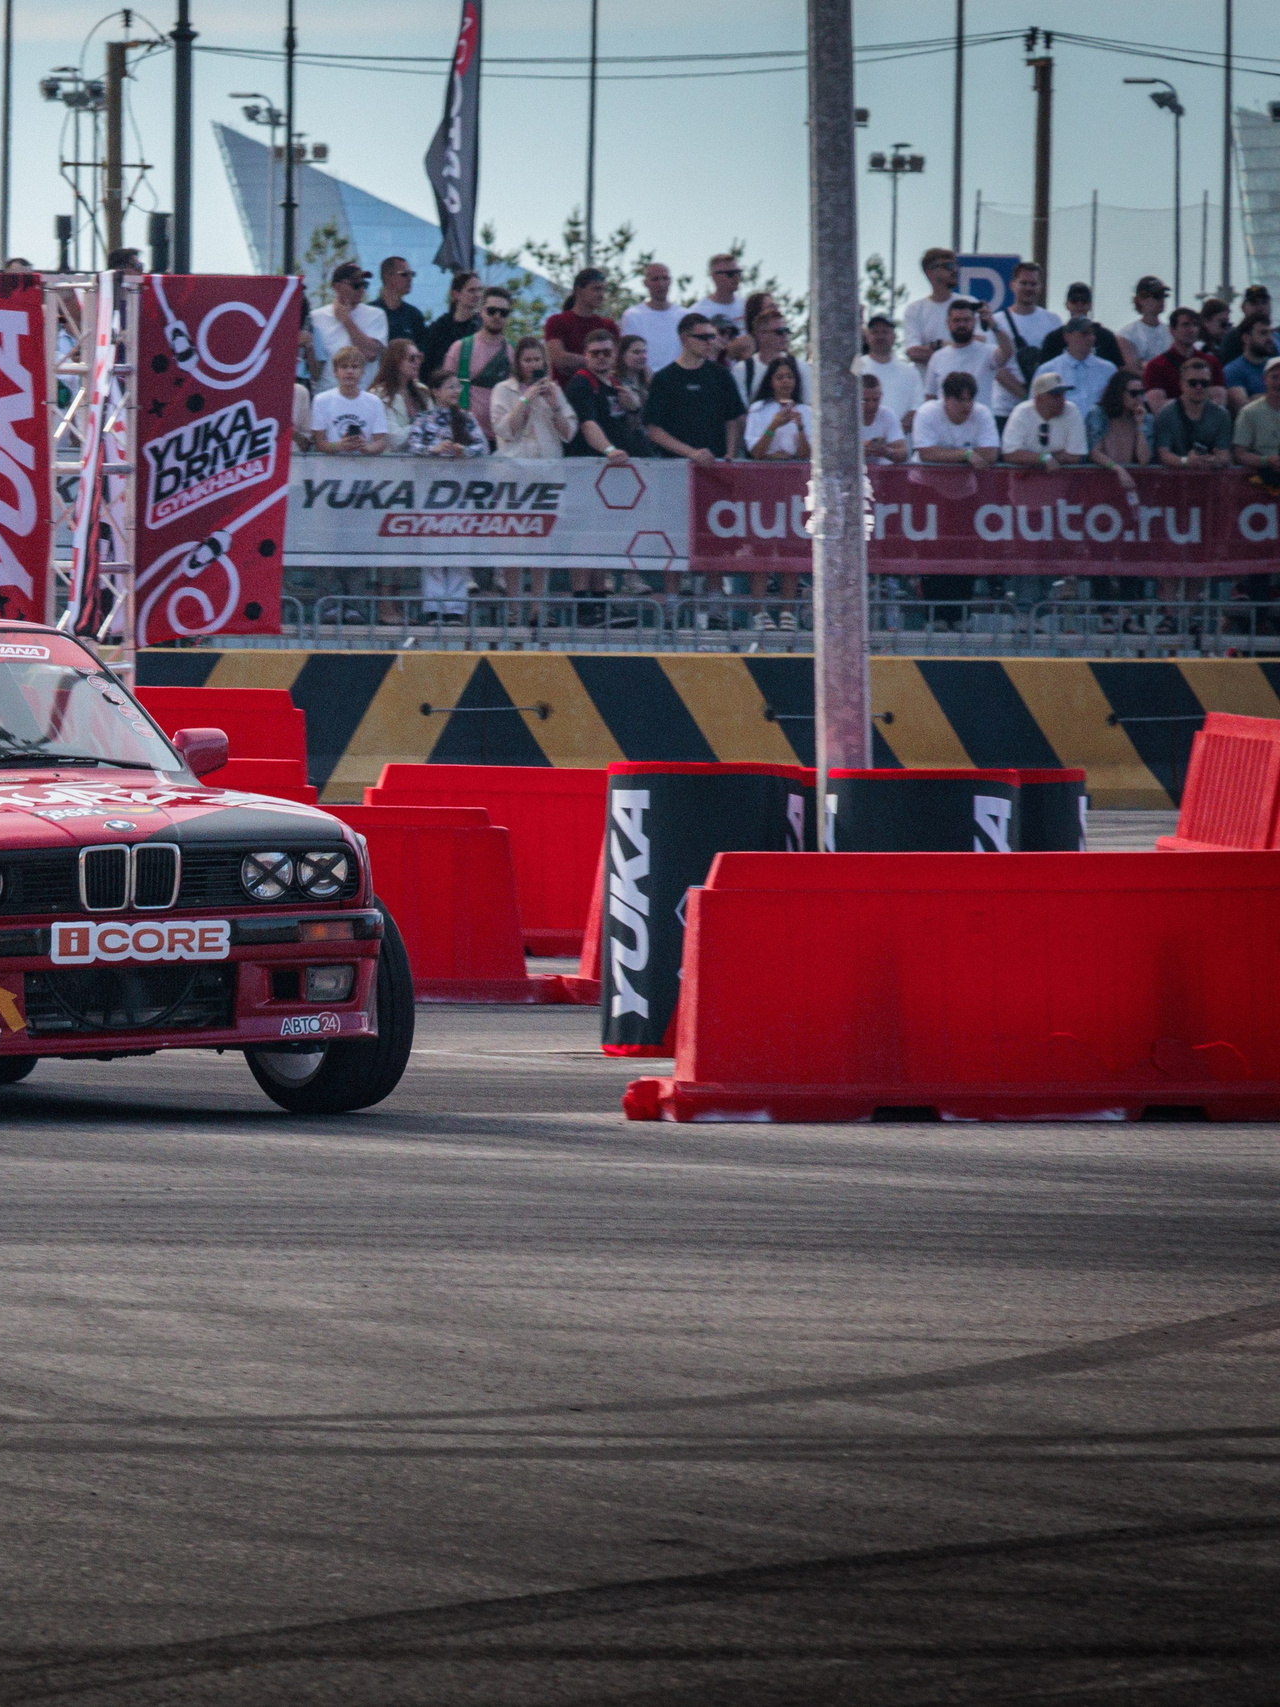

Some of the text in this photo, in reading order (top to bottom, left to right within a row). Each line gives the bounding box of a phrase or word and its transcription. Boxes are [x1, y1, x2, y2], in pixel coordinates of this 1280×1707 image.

[148, 405, 252, 471] YUKA
[154, 424, 273, 504] DRIVE
[156, 459, 266, 518] GYMKHANA
[302, 478, 567, 511] YUKA DRIVE
[387, 515, 544, 535] GYMKHANA
[973, 498, 1202, 544] auto.ru
[610, 789, 650, 1019] YUKA
